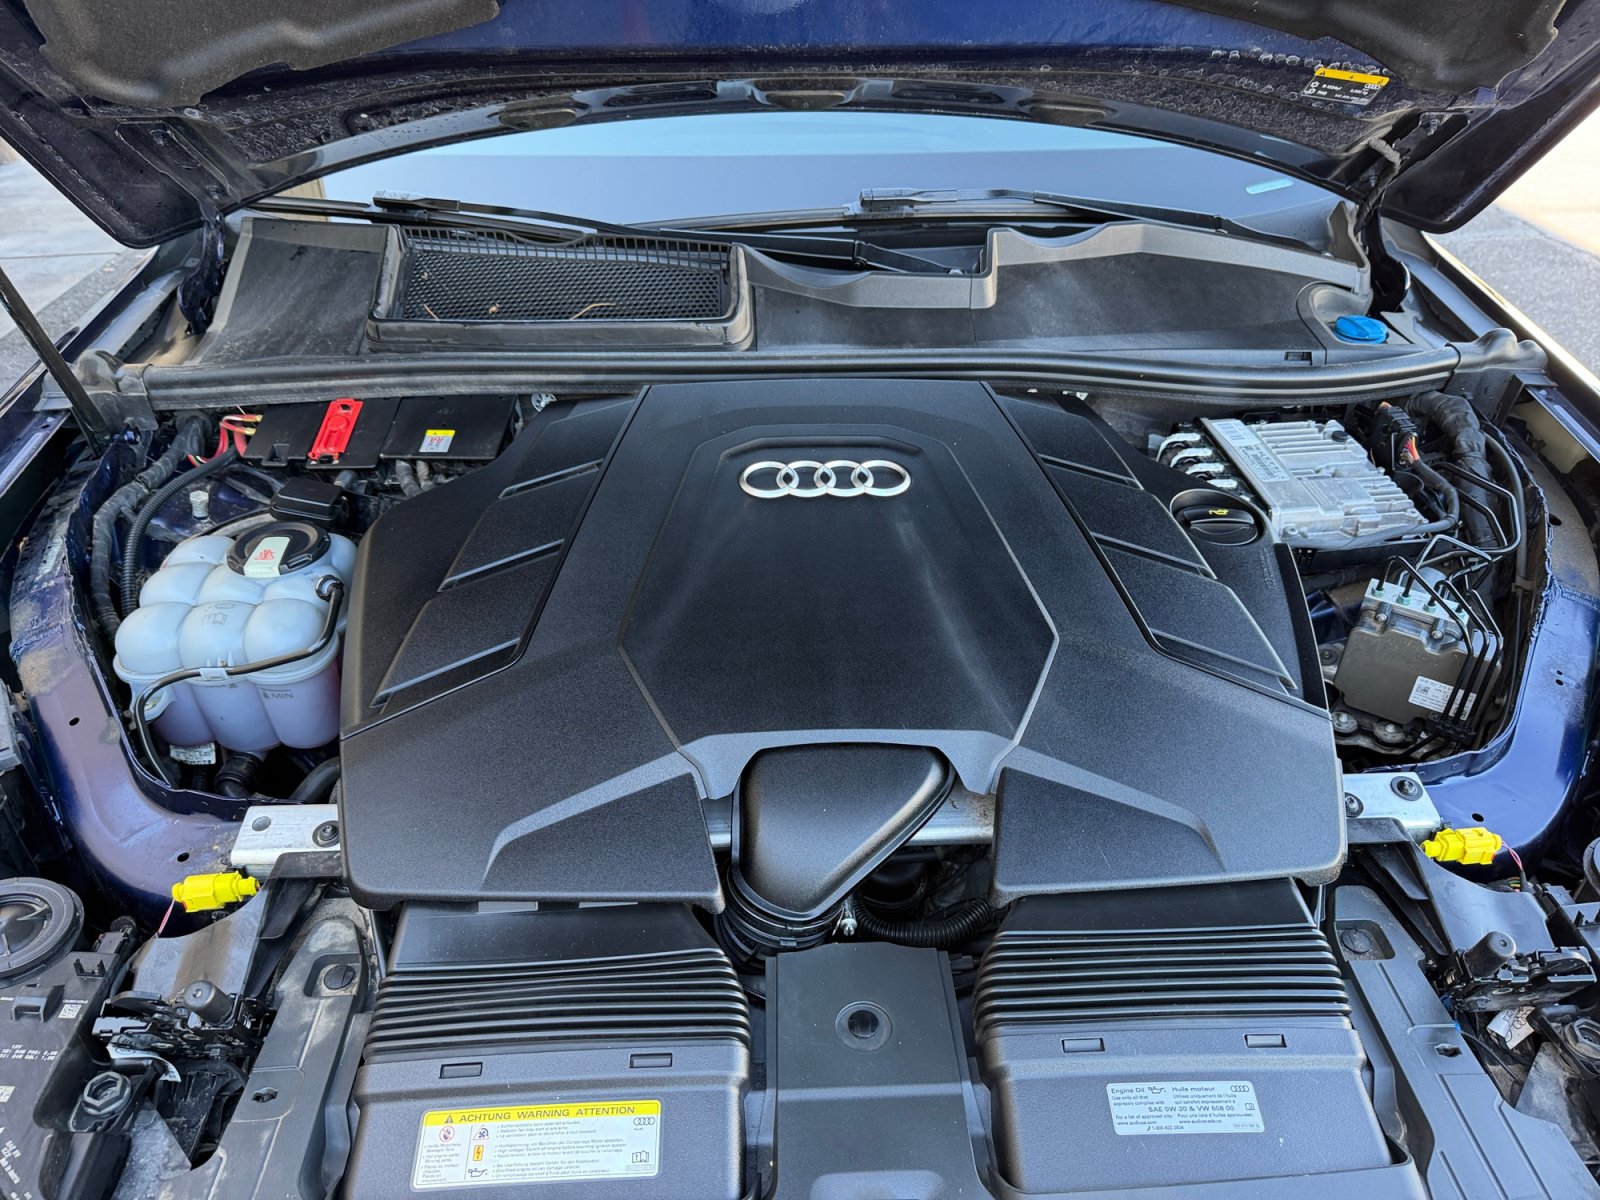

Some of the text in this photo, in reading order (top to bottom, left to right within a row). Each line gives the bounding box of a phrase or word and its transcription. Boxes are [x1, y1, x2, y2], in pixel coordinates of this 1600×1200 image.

[460, 1107, 635, 1122] ACHTUNG WARNING ATTENTION
